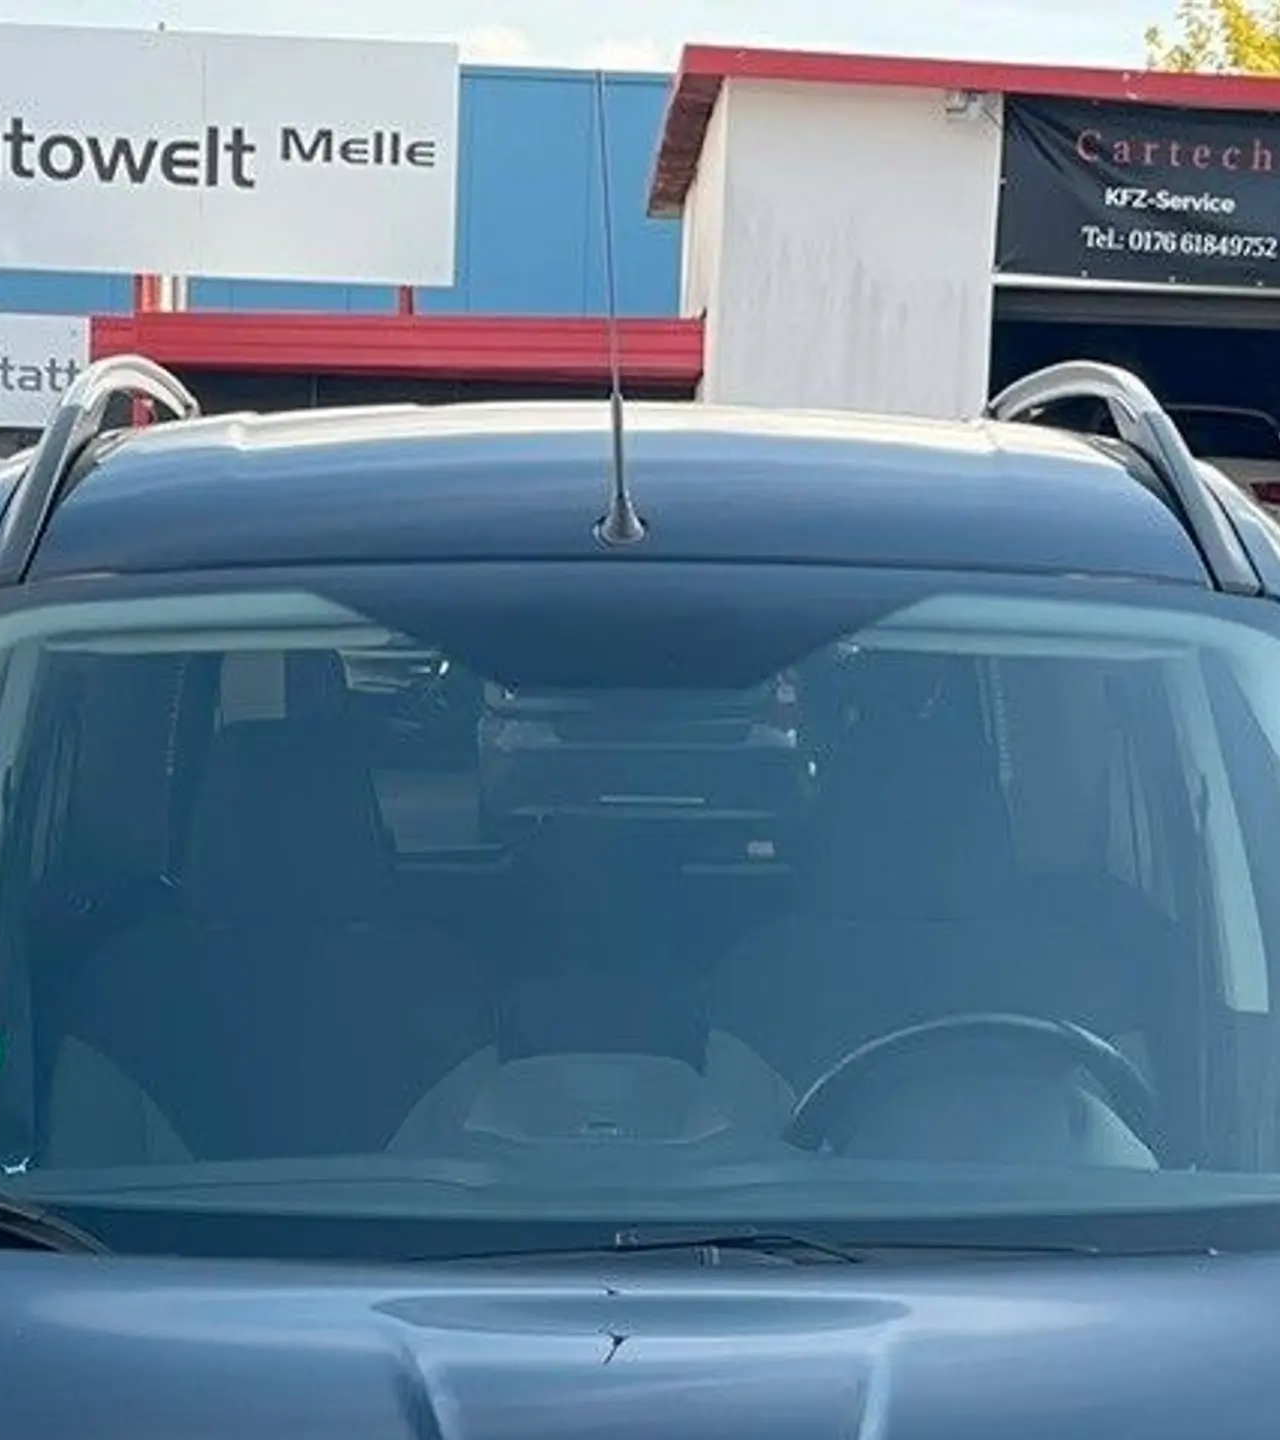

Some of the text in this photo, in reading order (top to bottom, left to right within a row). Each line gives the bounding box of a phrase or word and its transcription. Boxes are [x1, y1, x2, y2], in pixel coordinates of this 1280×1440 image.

[280, 126, 436, 167] Melle
[1076, 129, 1273, 171] Cartech
[1105, 187, 1237, 214] KFZ-Service
[1128, 229, 1176, 253] 0176
[1180, 232, 1278, 258] 61849752
